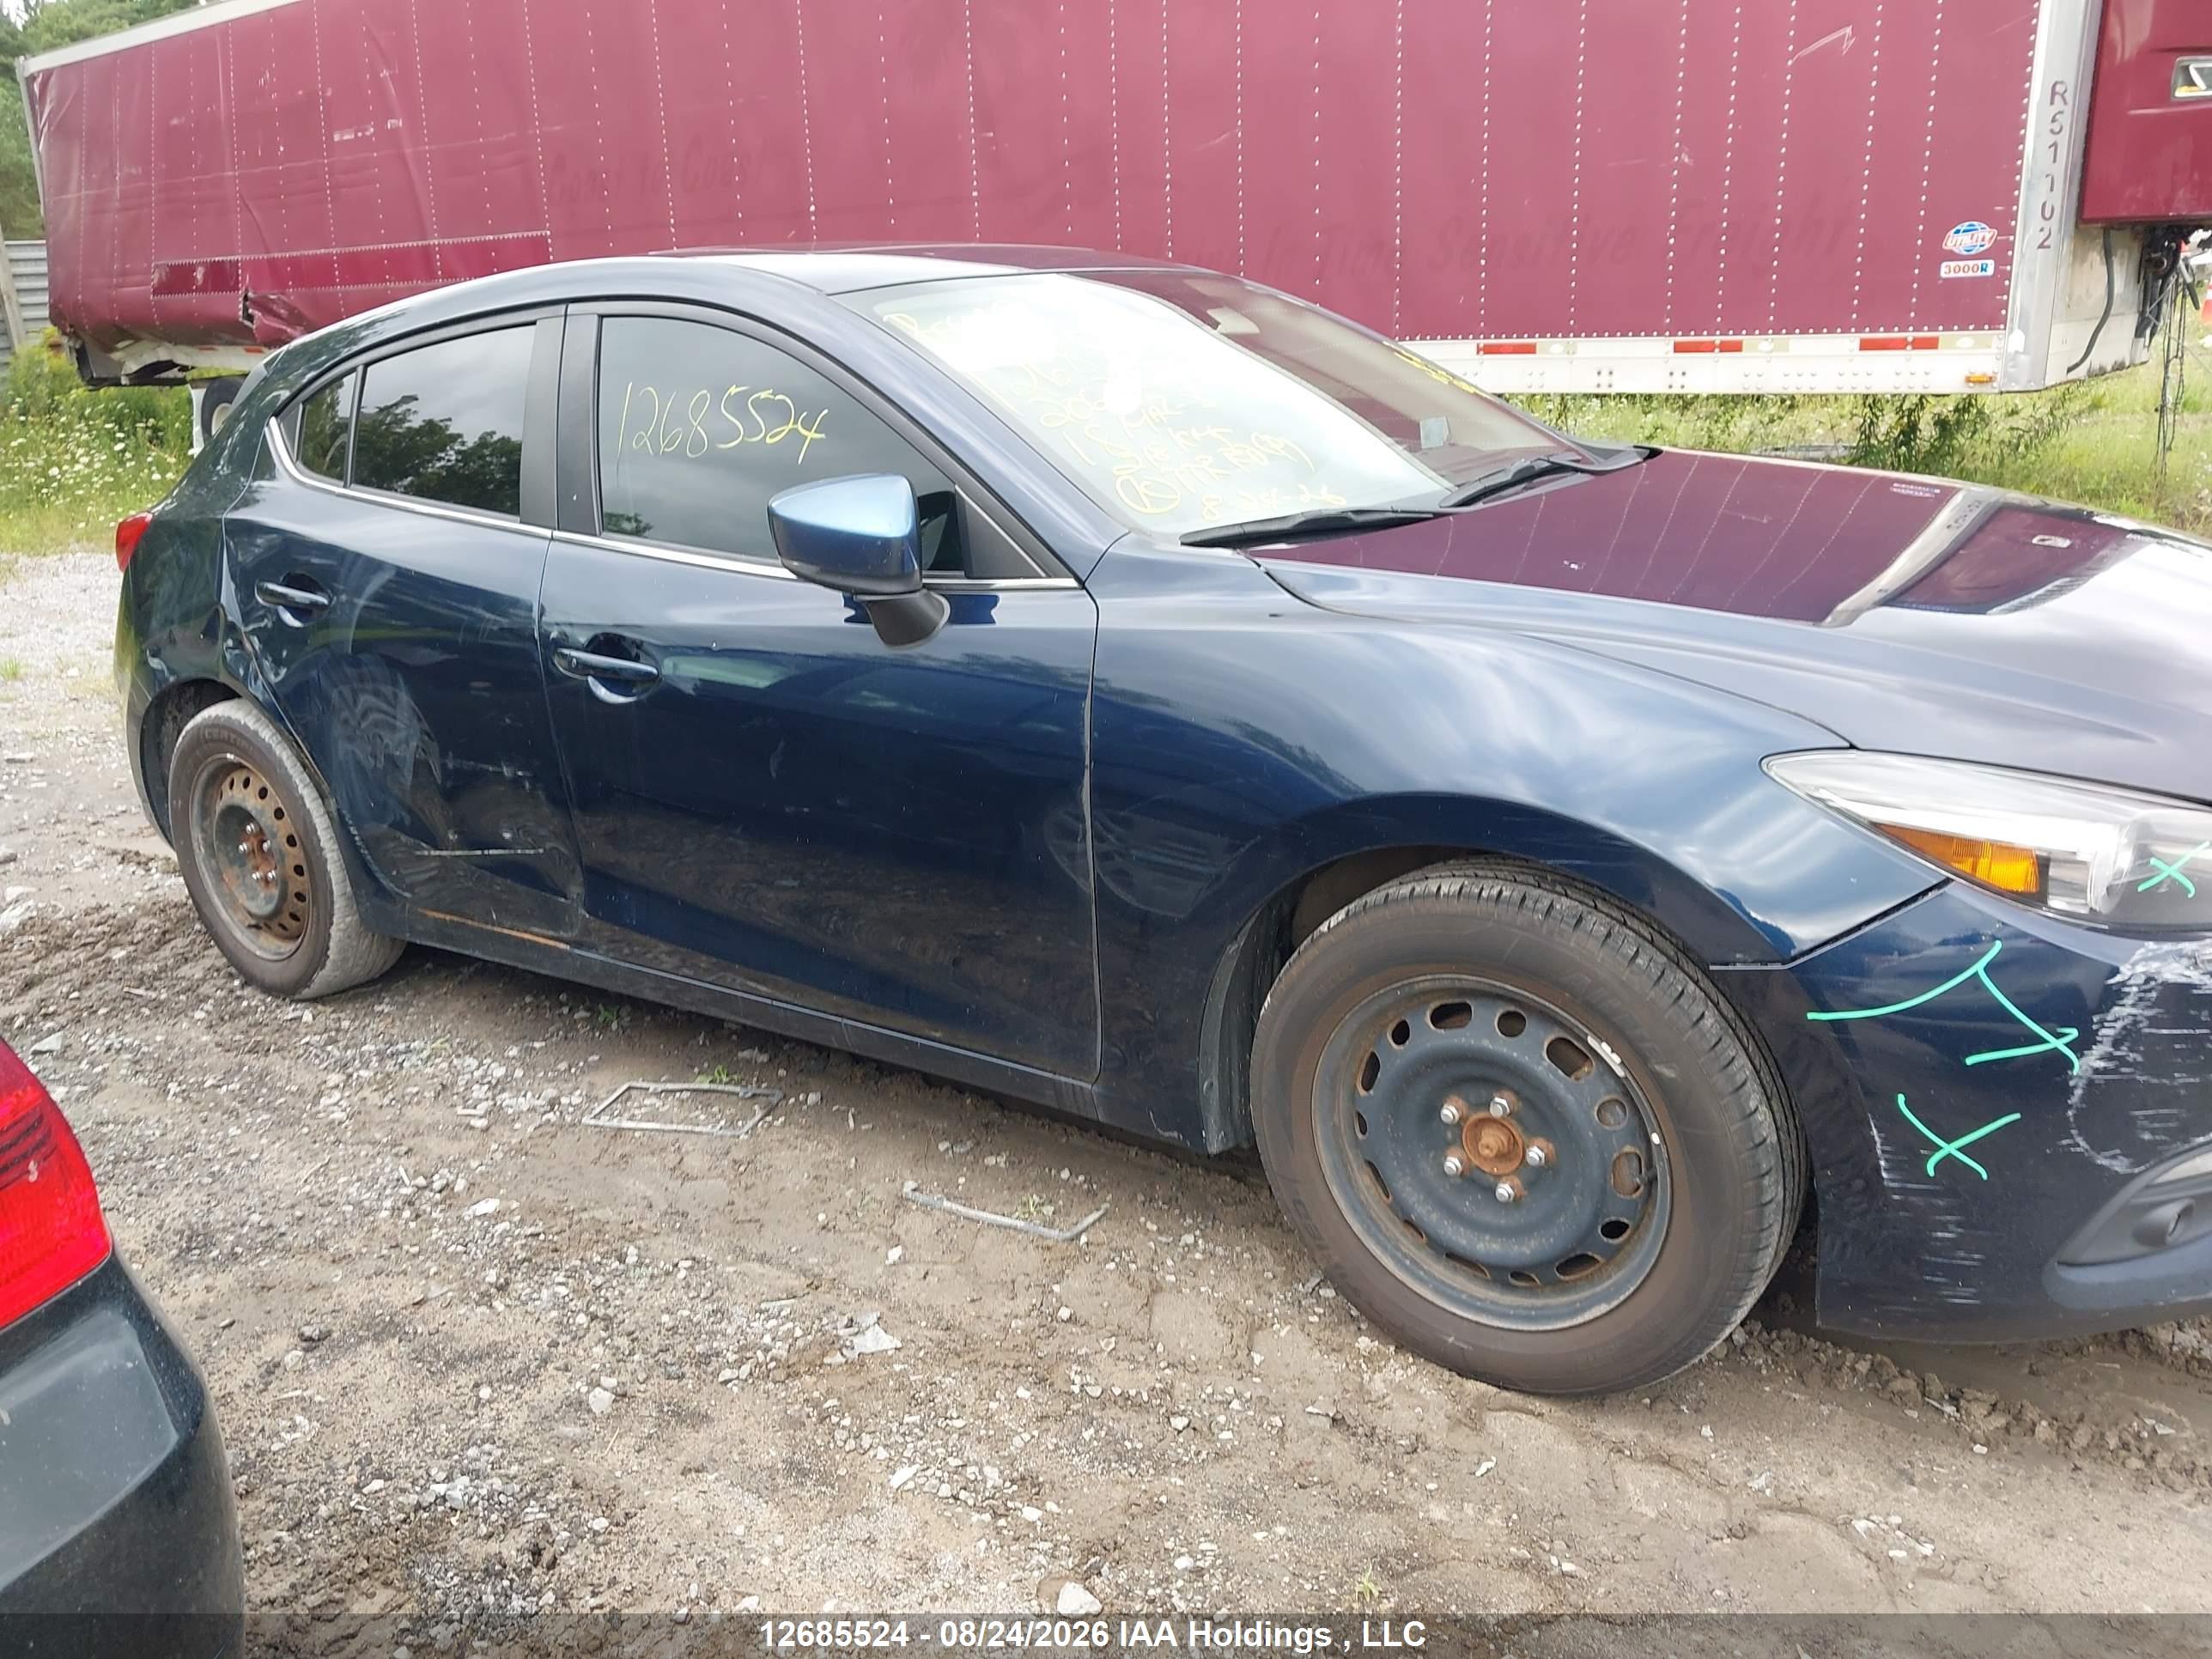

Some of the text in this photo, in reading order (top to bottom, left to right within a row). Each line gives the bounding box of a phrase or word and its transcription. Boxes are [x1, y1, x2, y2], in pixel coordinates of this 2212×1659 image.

[1944, 230, 1995, 249] UTILITY
[1943, 262, 1989, 275] 3000R
[617, 381, 829, 465] 12685524
